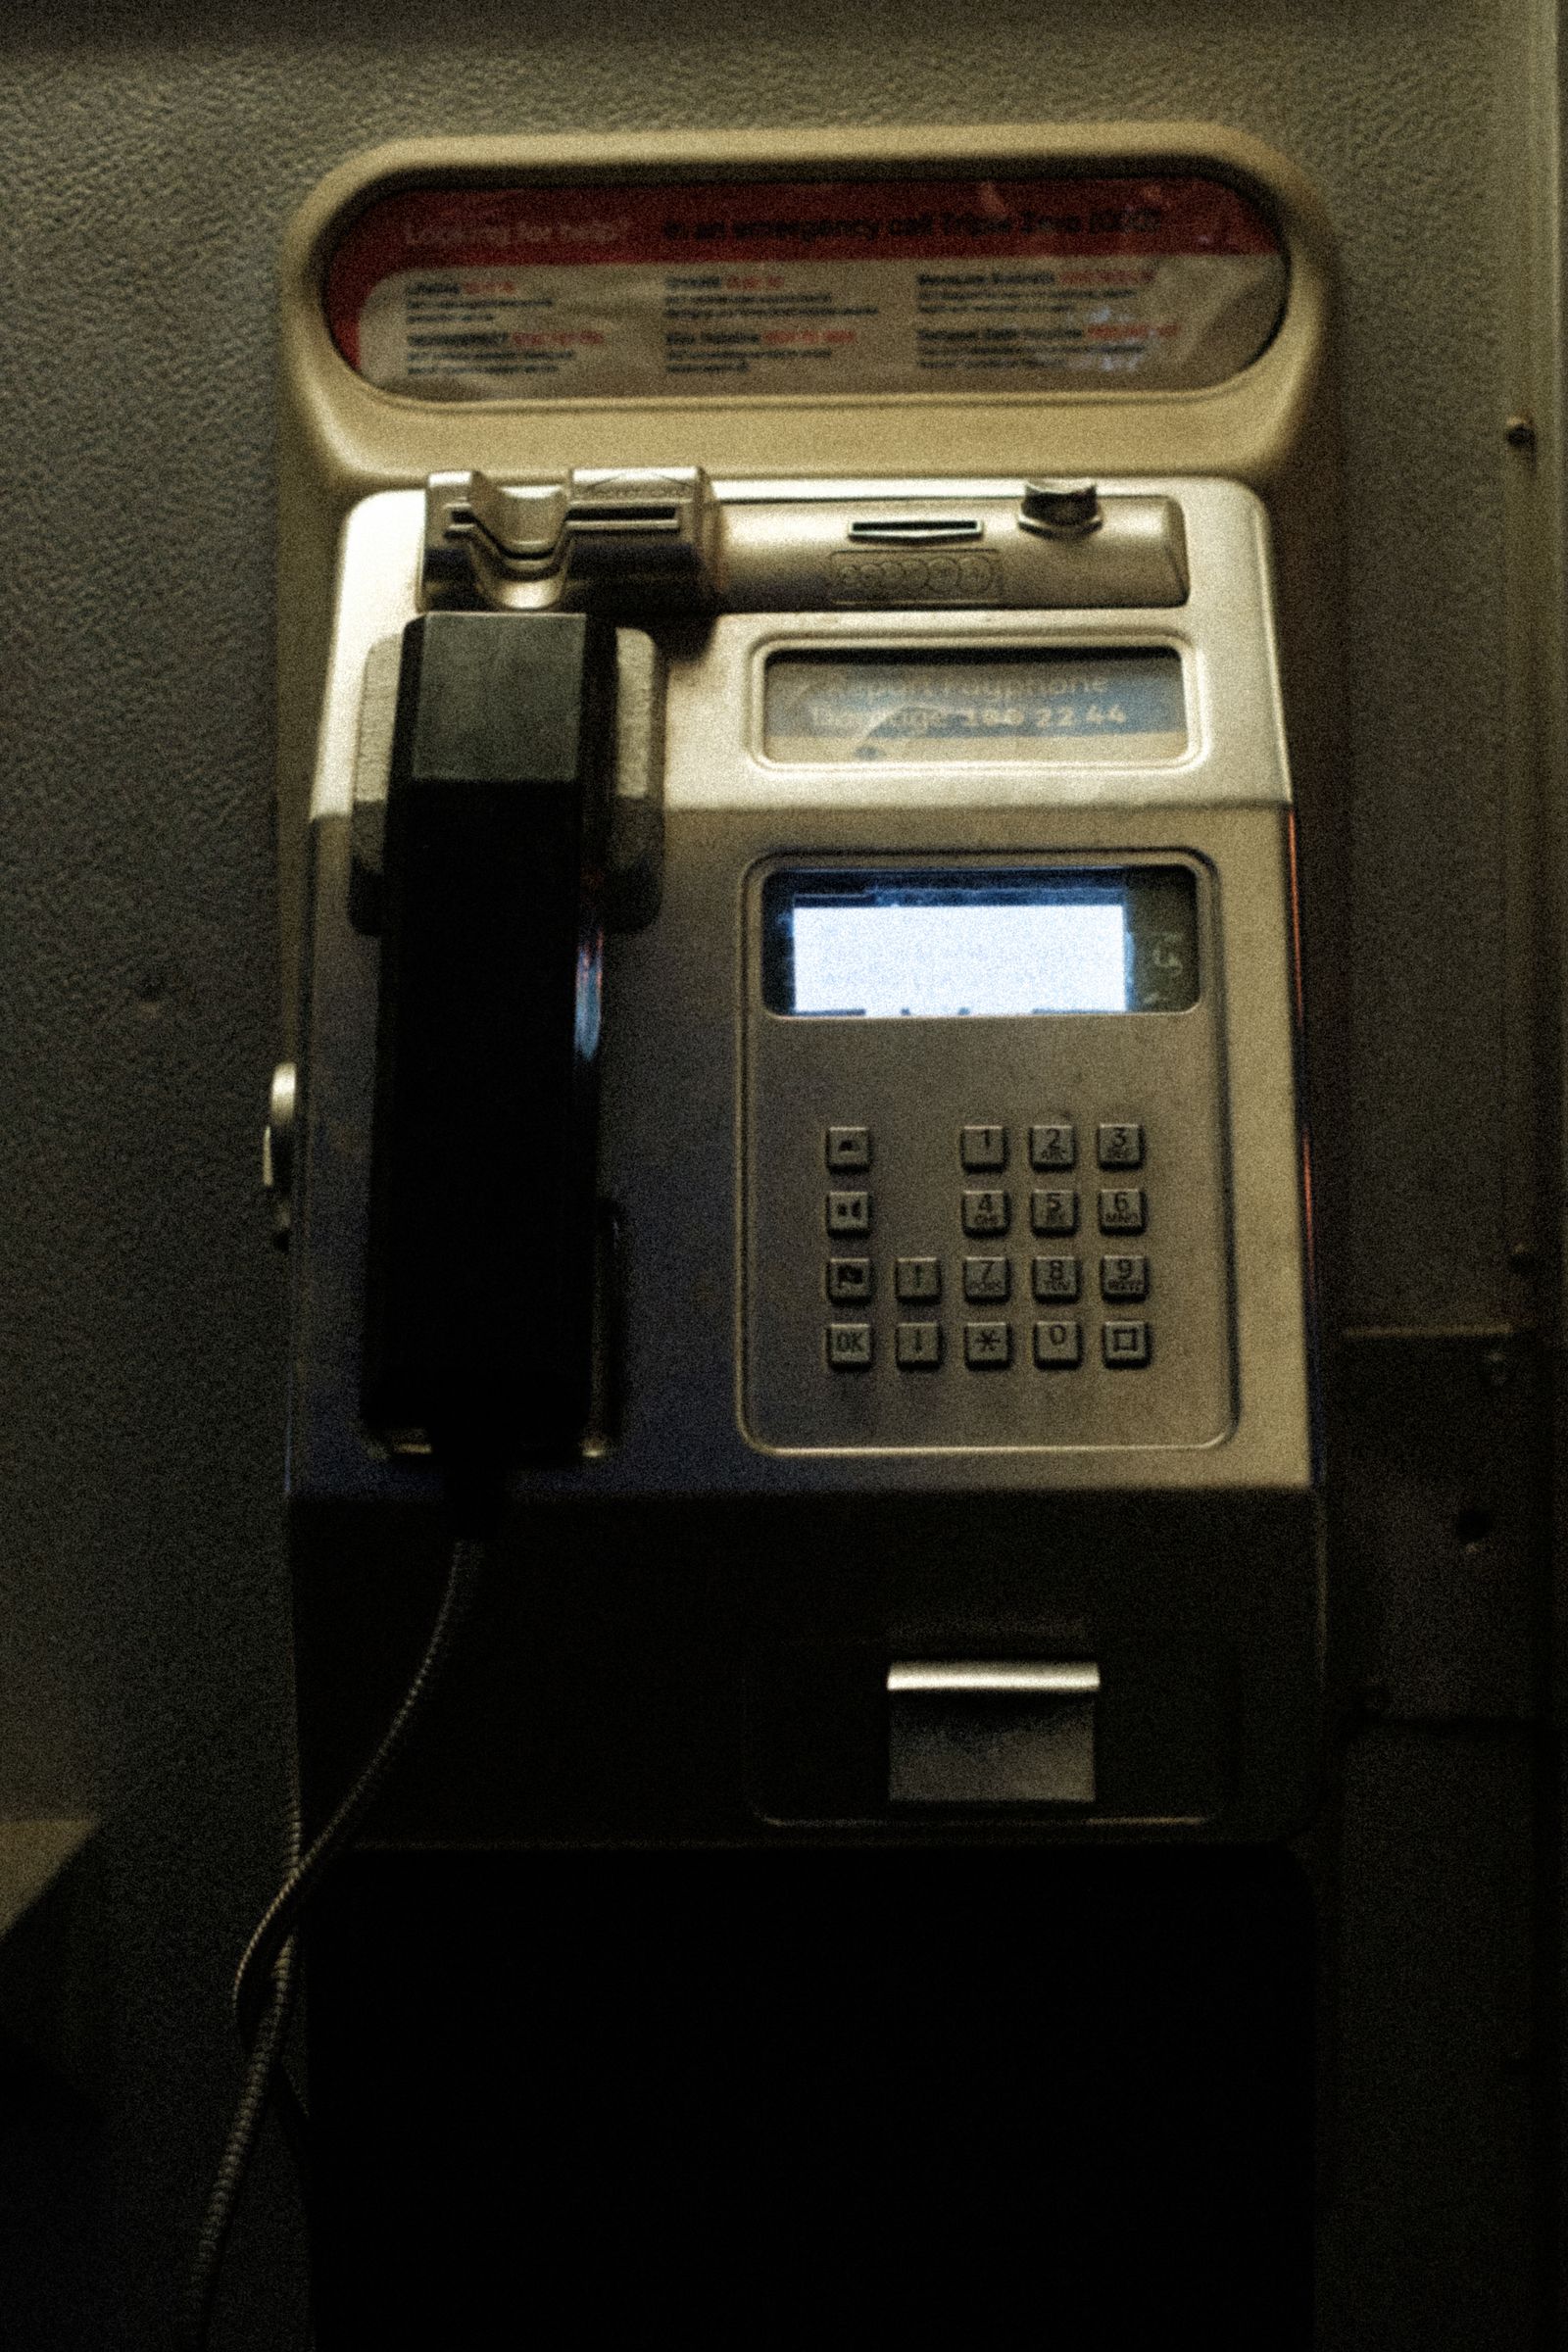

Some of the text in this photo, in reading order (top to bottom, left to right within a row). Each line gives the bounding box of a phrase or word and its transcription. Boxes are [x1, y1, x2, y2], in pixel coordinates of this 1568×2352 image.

[516, 220, 551, 244] for
[1032, 706, 1074, 728] 22
[1084, 703, 1128, 724] 44
[1046, 1129, 1061, 1150] 2
[1112, 1127, 1128, 1149] 3
[978, 1193, 993, 1213] 4
[1046, 1193, 1061, 1213] 5
[1113, 1192, 1129, 1212] 6
[980, 1260, 996, 1282] 7
[1049, 1259, 1064, 1280] 8
[1116, 1259, 1133, 1280] 9
[835, 1332, 863, 1352] OK
[1049, 1324, 1066, 1346] 0
